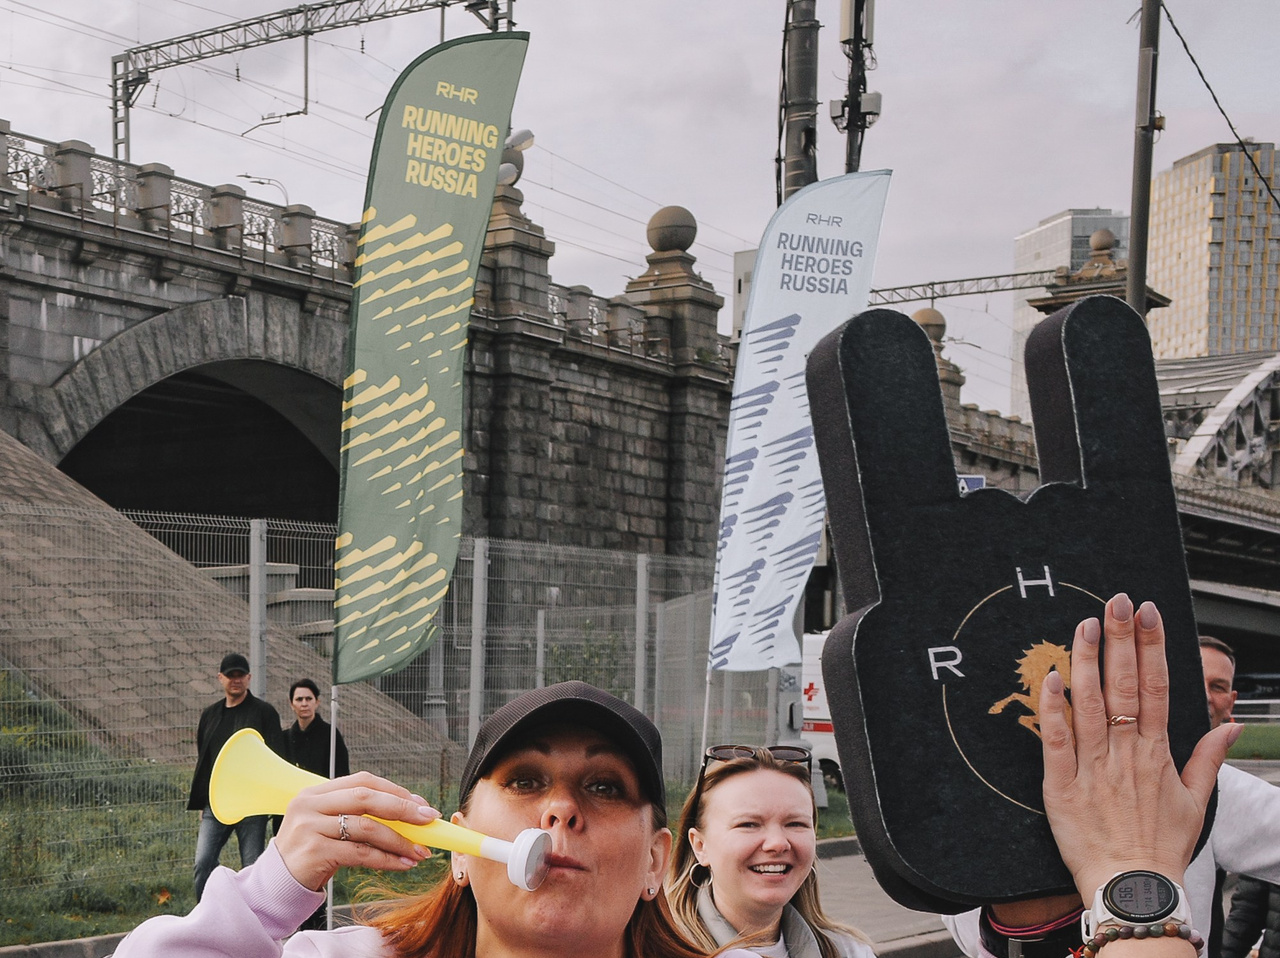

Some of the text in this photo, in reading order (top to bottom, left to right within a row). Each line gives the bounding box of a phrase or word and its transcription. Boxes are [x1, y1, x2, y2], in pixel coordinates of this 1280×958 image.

[436, 81, 479, 105] RHR
[401, 104, 499, 149] RUNNING
[406, 132, 487, 173] HEROES
[405, 159, 478, 199] RUSSIA
[805, 213, 843, 228] RHR
[777, 232, 863, 258] RUNNING
[781, 252, 853, 276] HEROES
[780, 272, 848, 295] RUSSIA
[1015, 565, 1056, 598] H
[927, 645, 966, 681] R
